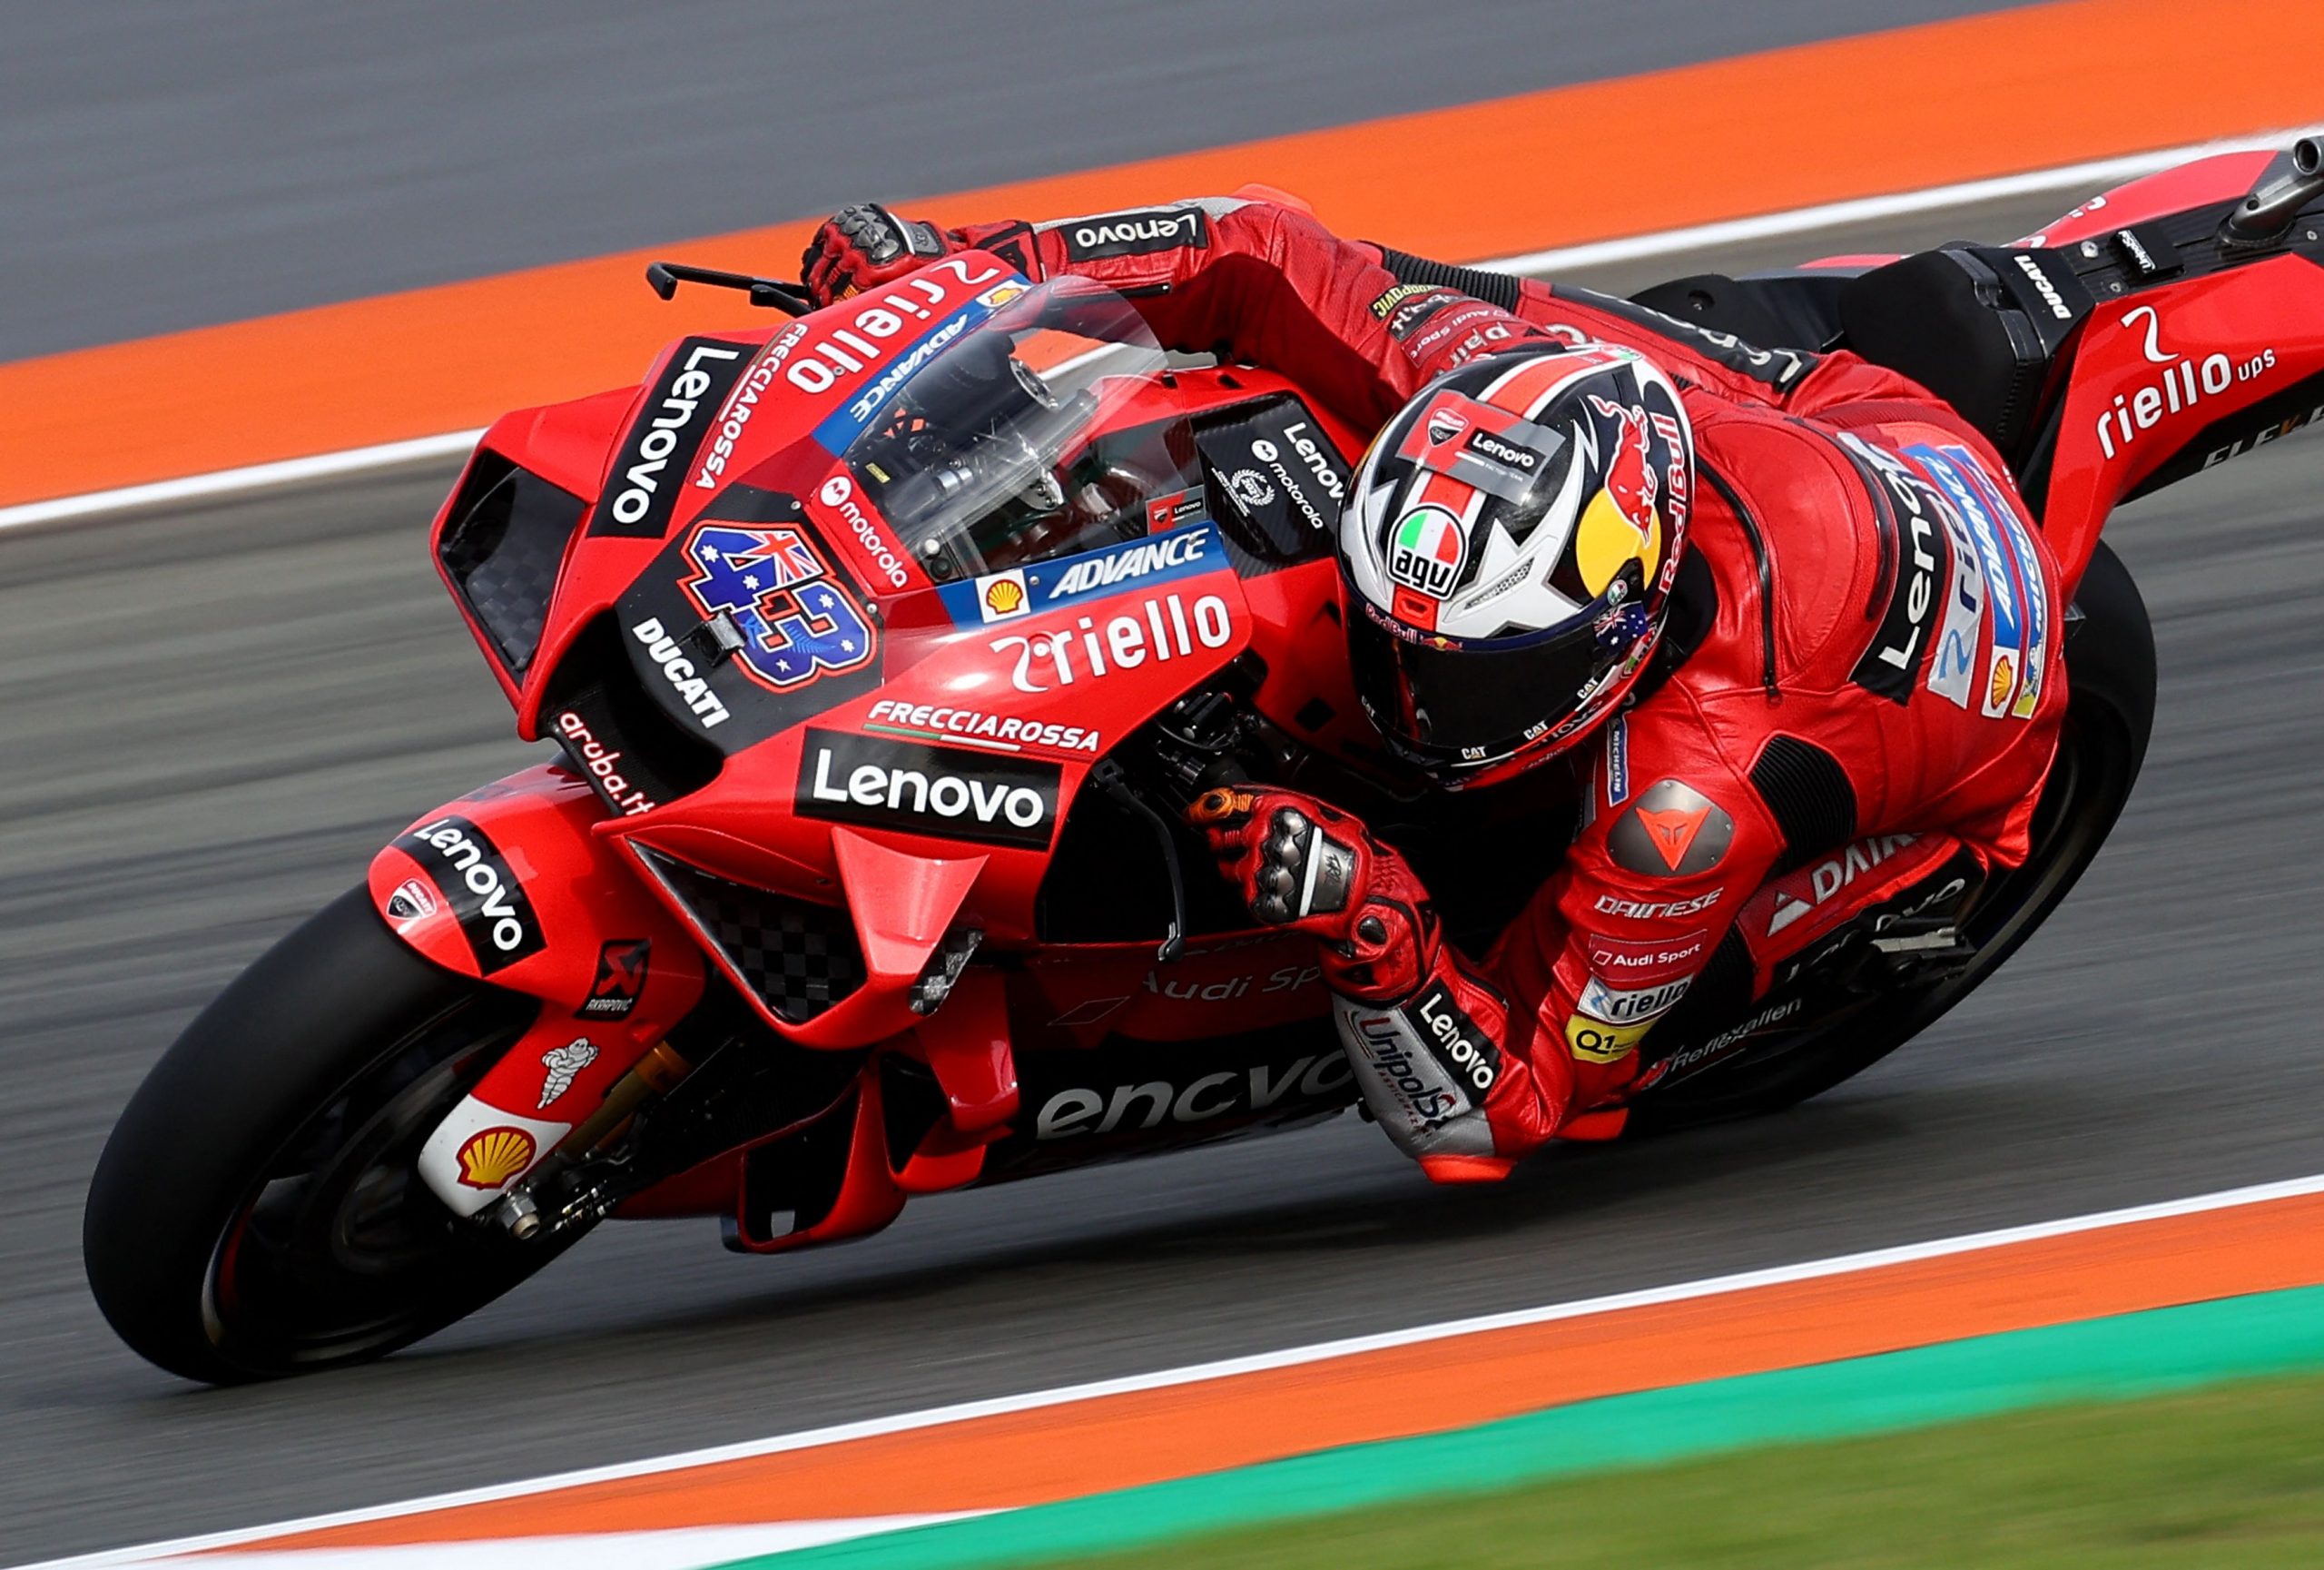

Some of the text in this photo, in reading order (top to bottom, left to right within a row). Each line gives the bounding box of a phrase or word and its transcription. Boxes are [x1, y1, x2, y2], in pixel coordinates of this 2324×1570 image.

[1076, 213, 1197, 248] Lenovo
[2014, 255, 2073, 319] DUCATI
[786, 279, 945, 394] riello
[850, 314, 969, 423] ADVANCE
[1410, 310, 1491, 359] Audi Sport
[612, 346, 740, 525] Lenovo
[695, 322, 808, 489] FRECCIAROSSA
[2096, 349, 2276, 459] riello ups
[1283, 422, 1345, 507] Lenov
[1472, 432, 1535, 467] Lenovo
[1174, 500, 1202, 514] Lenovo
[1270, 463, 1324, 529] motorola
[840, 501, 908, 588] motorola
[1049, 528, 1209, 599] ADVANCE
[1394, 548, 1452, 589] agv
[1914, 456, 2014, 630] ADVANCE
[681, 522, 875, 692] 43
[1051, 594, 1232, 686] riello
[632, 617, 730, 729] DUCATI
[1576, 676, 1599, 699] CAT
[559, 711, 655, 816] aruba.it
[868, 700, 1099, 752] FRECCIAROSSA
[1461, 746, 1487, 760] CAT
[1523, 720, 1549, 741] CAT
[1611, 730, 1622, 794] MICHELIN
[812, 747, 1044, 828] Lenovo
[413, 819, 523, 952] Lenovo
[1594, 886, 1724, 919] DAINESE
[1613, 943, 1701, 967] Audi Sport
[1610, 982, 1689, 1018] riello
[1670, 998, 1802, 1073] Reflexallen
[1359, 1017, 1457, 1131] UnipolS
[1420, 992, 1494, 1090] Lenovo
